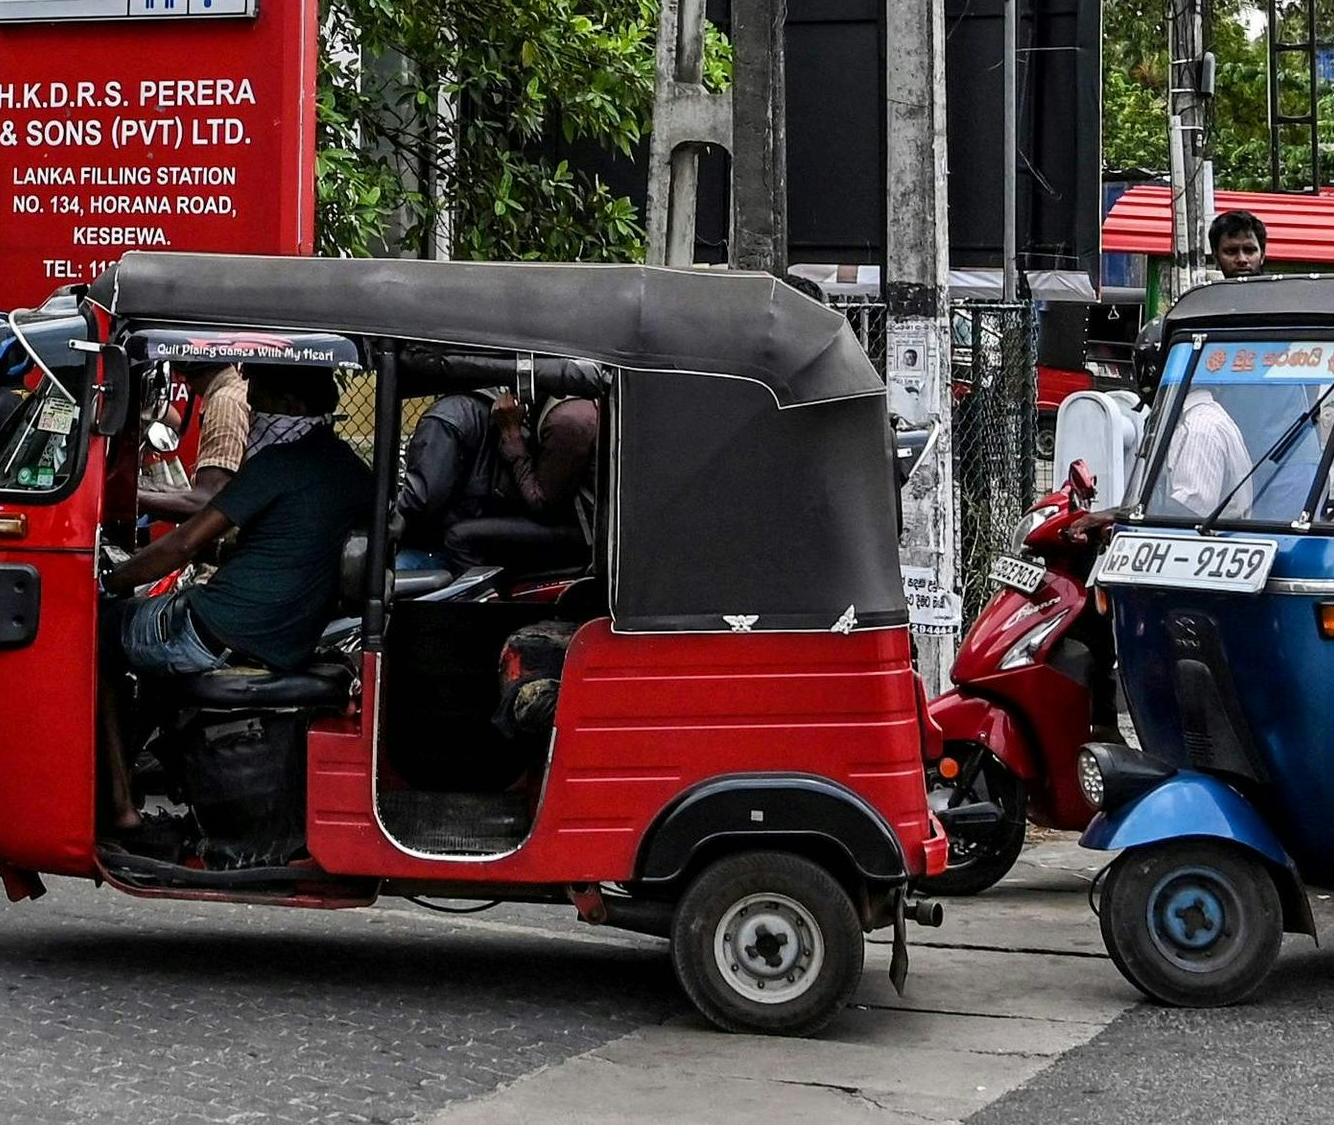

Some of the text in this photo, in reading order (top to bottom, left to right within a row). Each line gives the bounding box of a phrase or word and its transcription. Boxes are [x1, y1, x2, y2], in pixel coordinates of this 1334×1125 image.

[140, 78, 256, 107] PERERA
[0, 116, 252, 149] & SONS (PVT) LTD.
[13, 167, 236, 185] LANKA FILLING STATION
[13, 196, 237, 218] NO. 134, HORANA ROAD,
[73, 228, 172, 246] KESBEWA.
[43, 260, 83, 278] TEL:
[284, 349, 301, 362] My
[1108, 555, 1129, 572] WP
